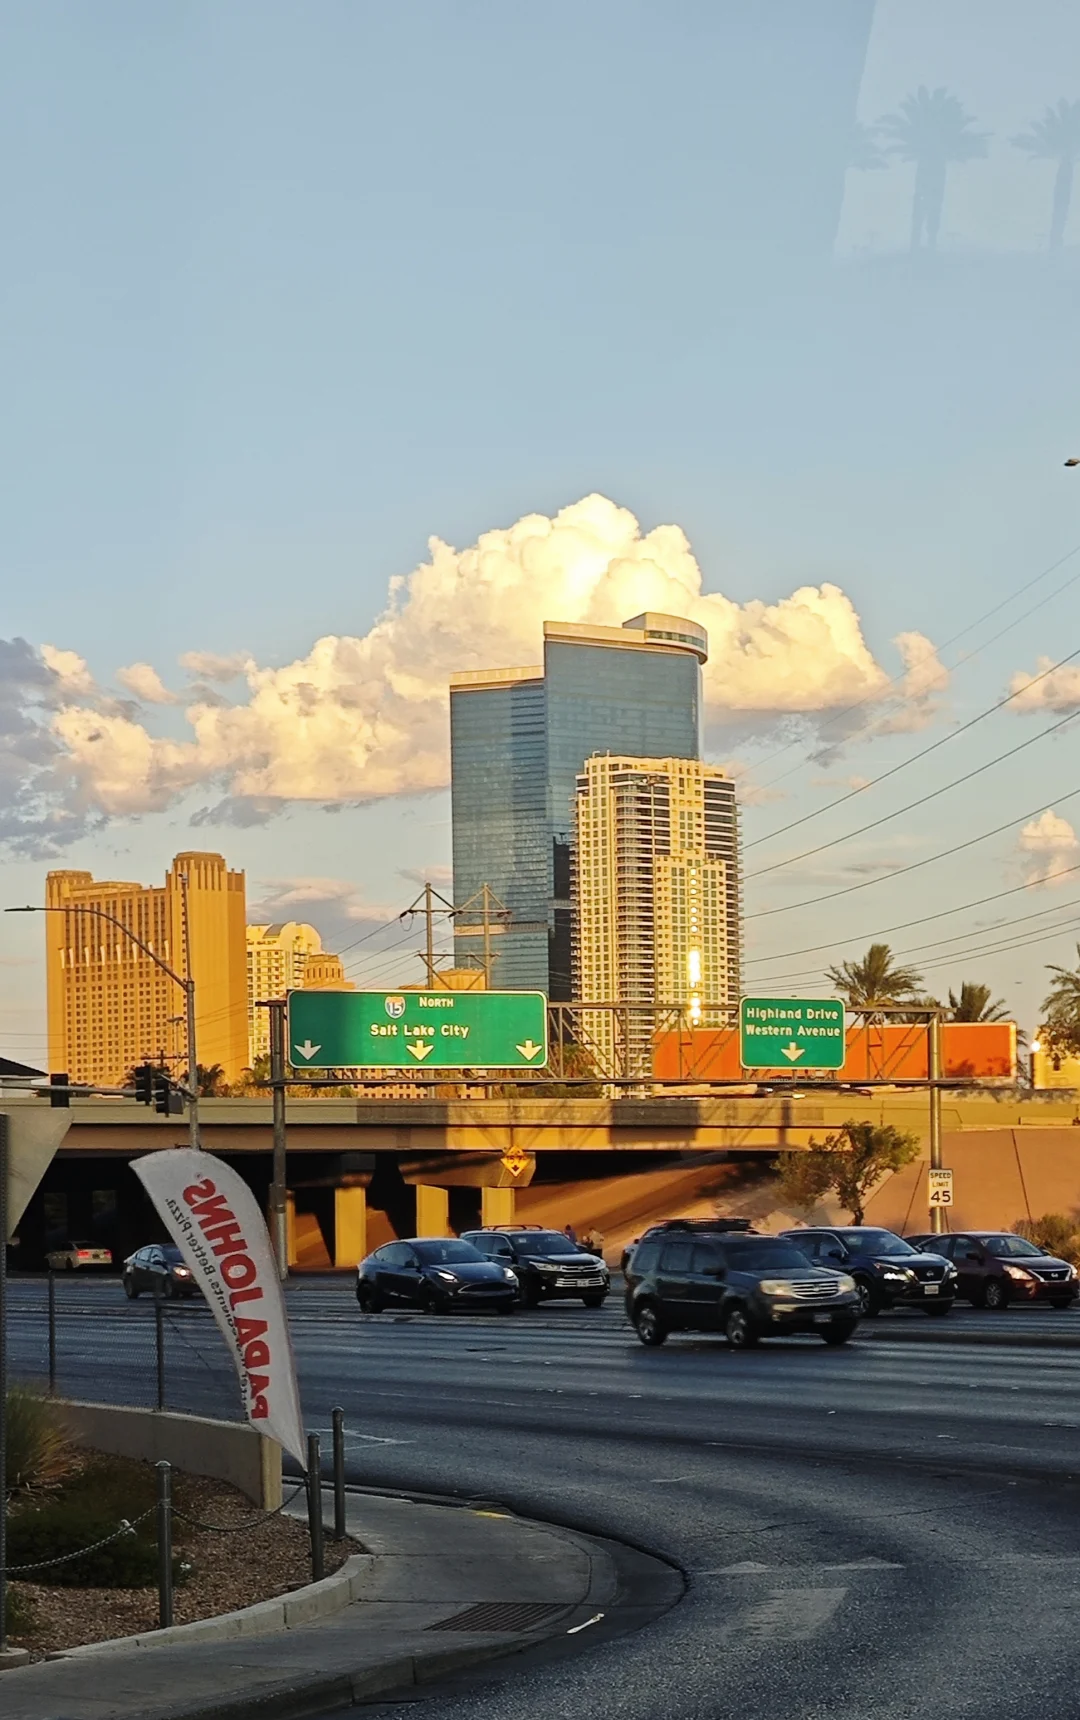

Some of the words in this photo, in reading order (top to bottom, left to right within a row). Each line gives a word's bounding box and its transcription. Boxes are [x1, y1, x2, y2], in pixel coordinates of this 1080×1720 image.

[388, 1001, 403, 1014] 15
[419, 996, 454, 1008] NORTH
[746, 1007, 802, 1022] Highland
[806, 1008, 839, 1020] Drive
[370, 1024, 398, 1036] Salt
[403, 1024, 435, 1036] Lake
[441, 1024, 469, 1039] City
[745, 1024, 793, 1036] Western
[796, 1025, 841, 1037] Avenue
[930, 1190, 951, 1203] 45
